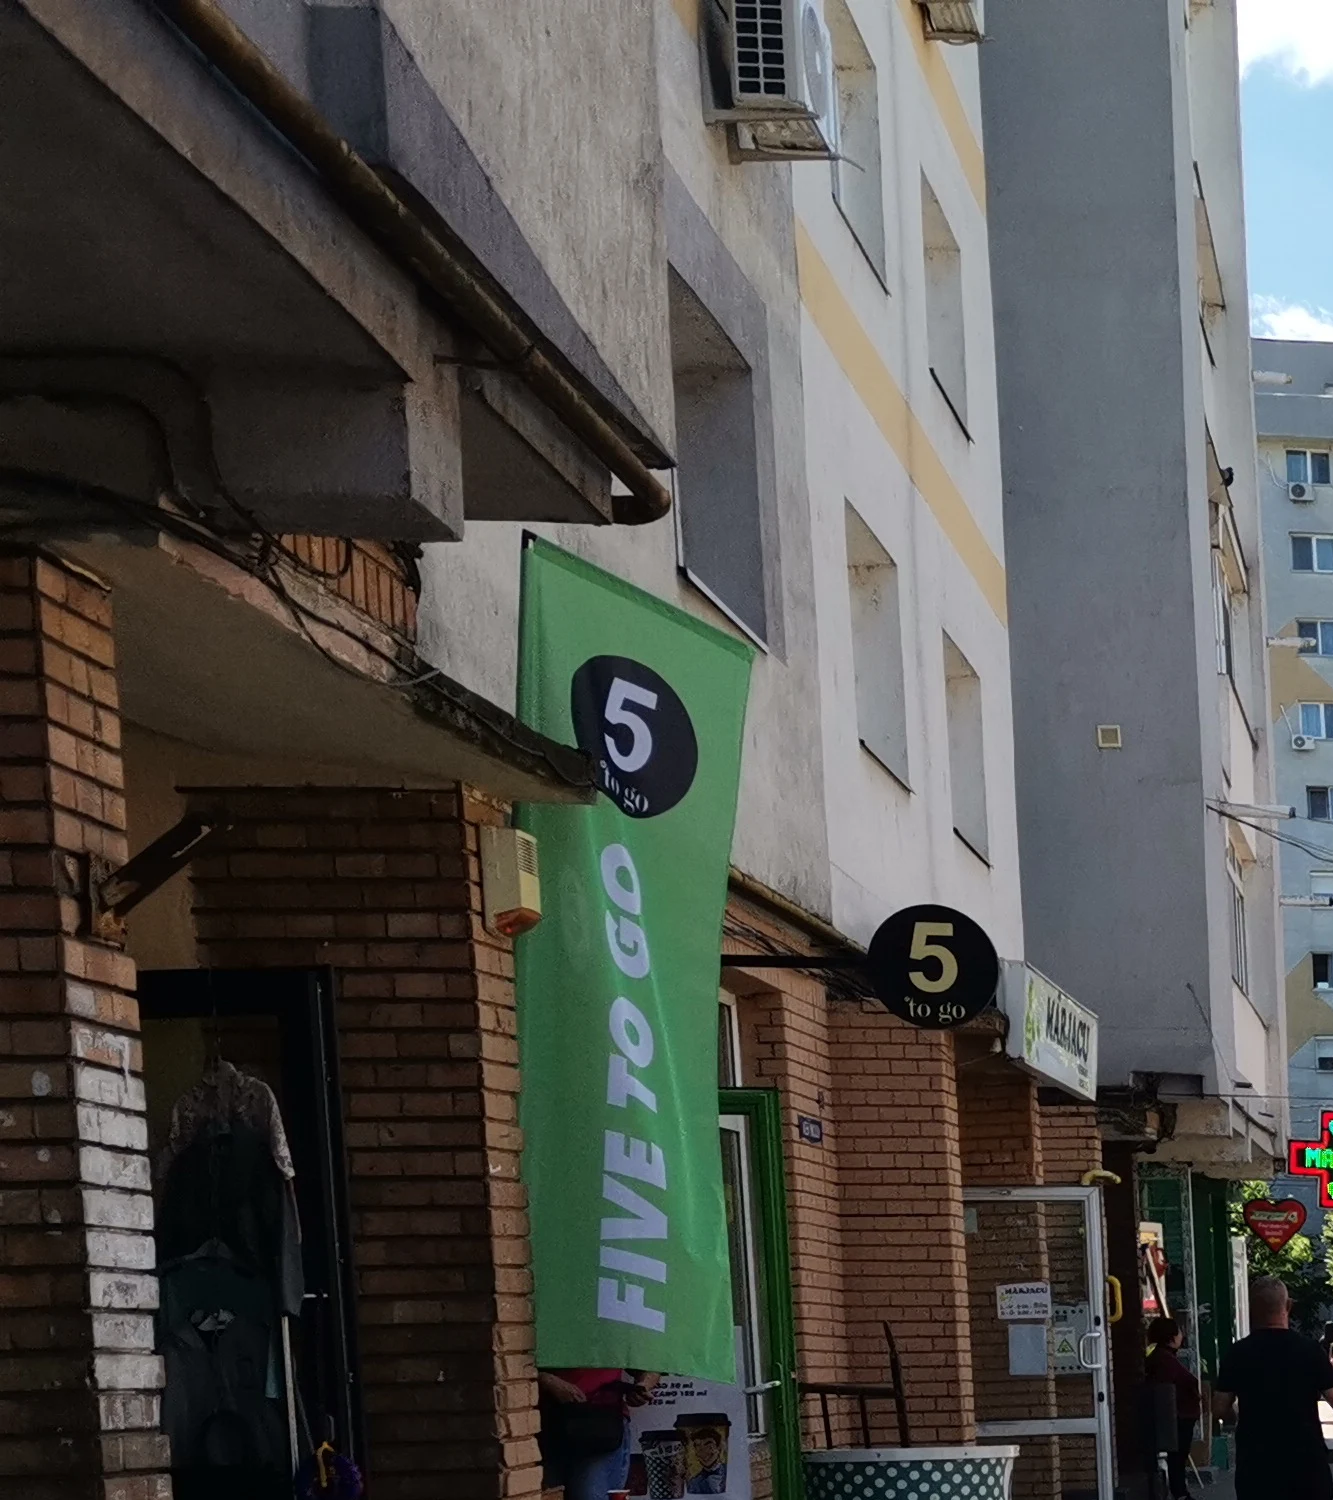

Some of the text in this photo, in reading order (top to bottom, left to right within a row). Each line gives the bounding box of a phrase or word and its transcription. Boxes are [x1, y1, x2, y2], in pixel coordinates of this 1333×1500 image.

[604, 677, 658, 773] 5
[624, 786, 649, 813] go
[908, 921, 958, 993] 5
[938, 1002, 966, 1024] go
[597, 843, 668, 1333] FIVE TO GO
